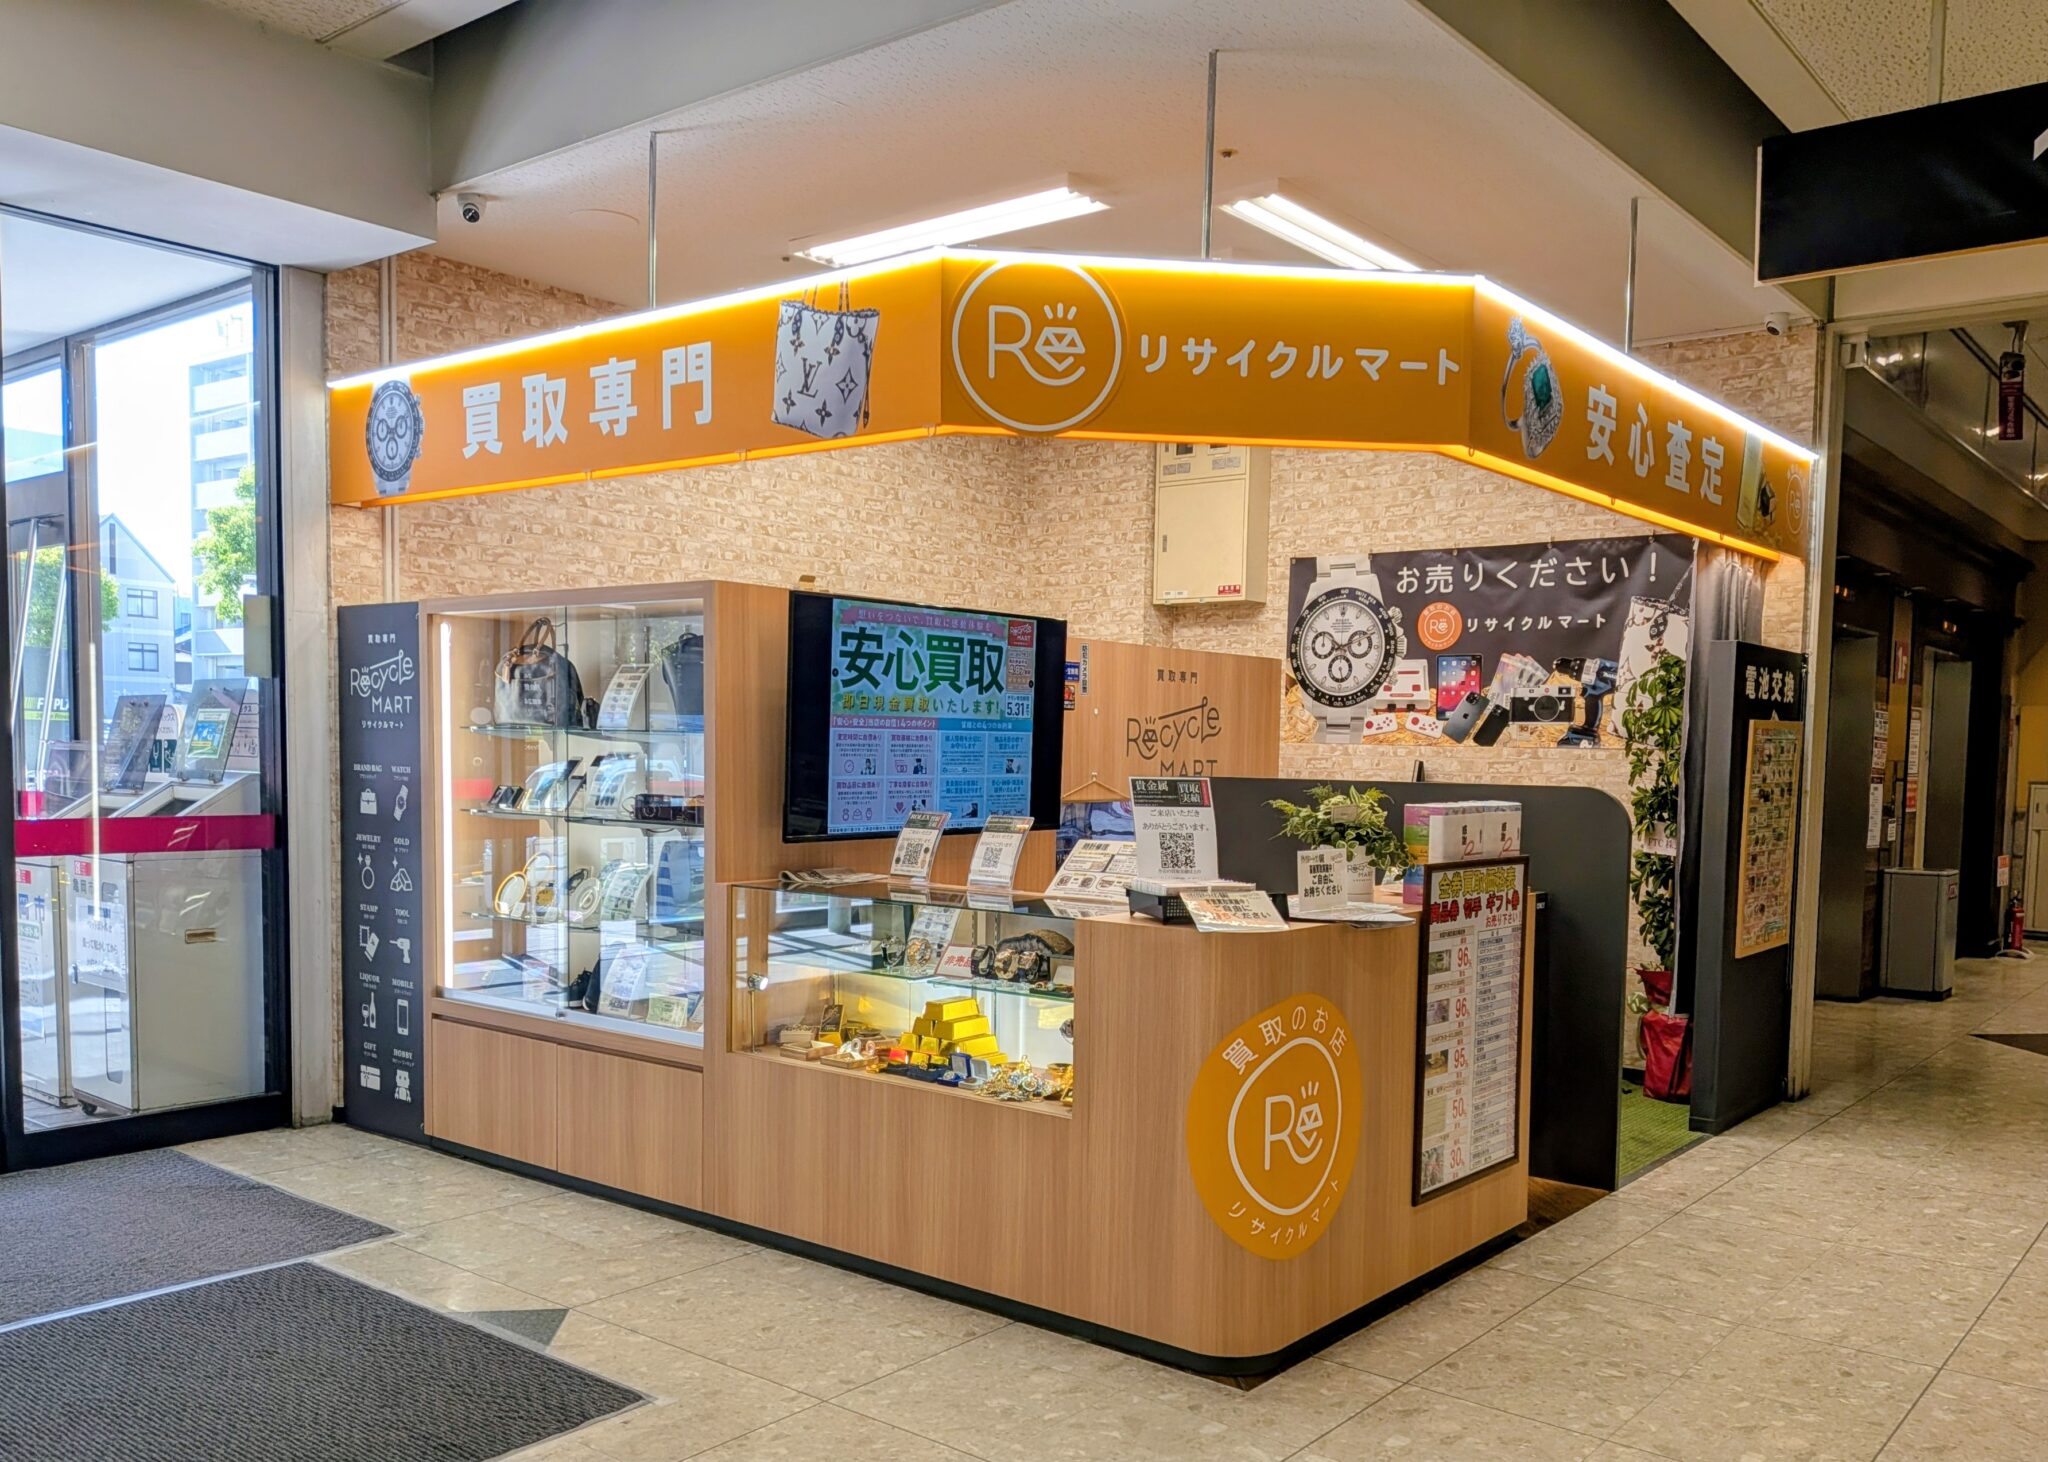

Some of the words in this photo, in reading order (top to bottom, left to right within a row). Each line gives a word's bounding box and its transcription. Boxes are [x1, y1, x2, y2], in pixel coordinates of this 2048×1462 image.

[1140, 334, 1461, 386] リサイクルマート
[462, 341, 713, 459] 買取専門
[1587, 384, 1724, 505] 安心査定
[1467, 613, 1606, 633] リサイクルマート
[839, 627, 1004, 695] 安心買取
[351, 649, 414, 697] Recycle
[1157, 669, 1198, 684] 買取専門
[1745, 665, 1795, 703] 電池交換
[372, 696, 413, 713] MART
[1007, 702, 1024, 716] 5.31
[362, 720, 404, 729] リサイクルマート
[1127, 696, 1221, 760] Recycle
[391, 766, 411, 774] WATCH
[356, 834, 381, 843] JEWELRY
[394, 837, 409, 846] GOLD
[1304, 884, 1342, 898] お持ちください
[360, 904, 378, 912] STAMP
[395, 908, 410, 917] TOOL
[359, 972, 380, 983] LIQUOR
[392, 978, 414, 989] MOBILE
[364, 1042, 376, 1051] GIFT
[1222, 1006, 1347, 1075] 買取のお店
[394, 1049, 413, 1060] HOBBY
[1228, 1179, 1340, 1245] リサイクルマート
